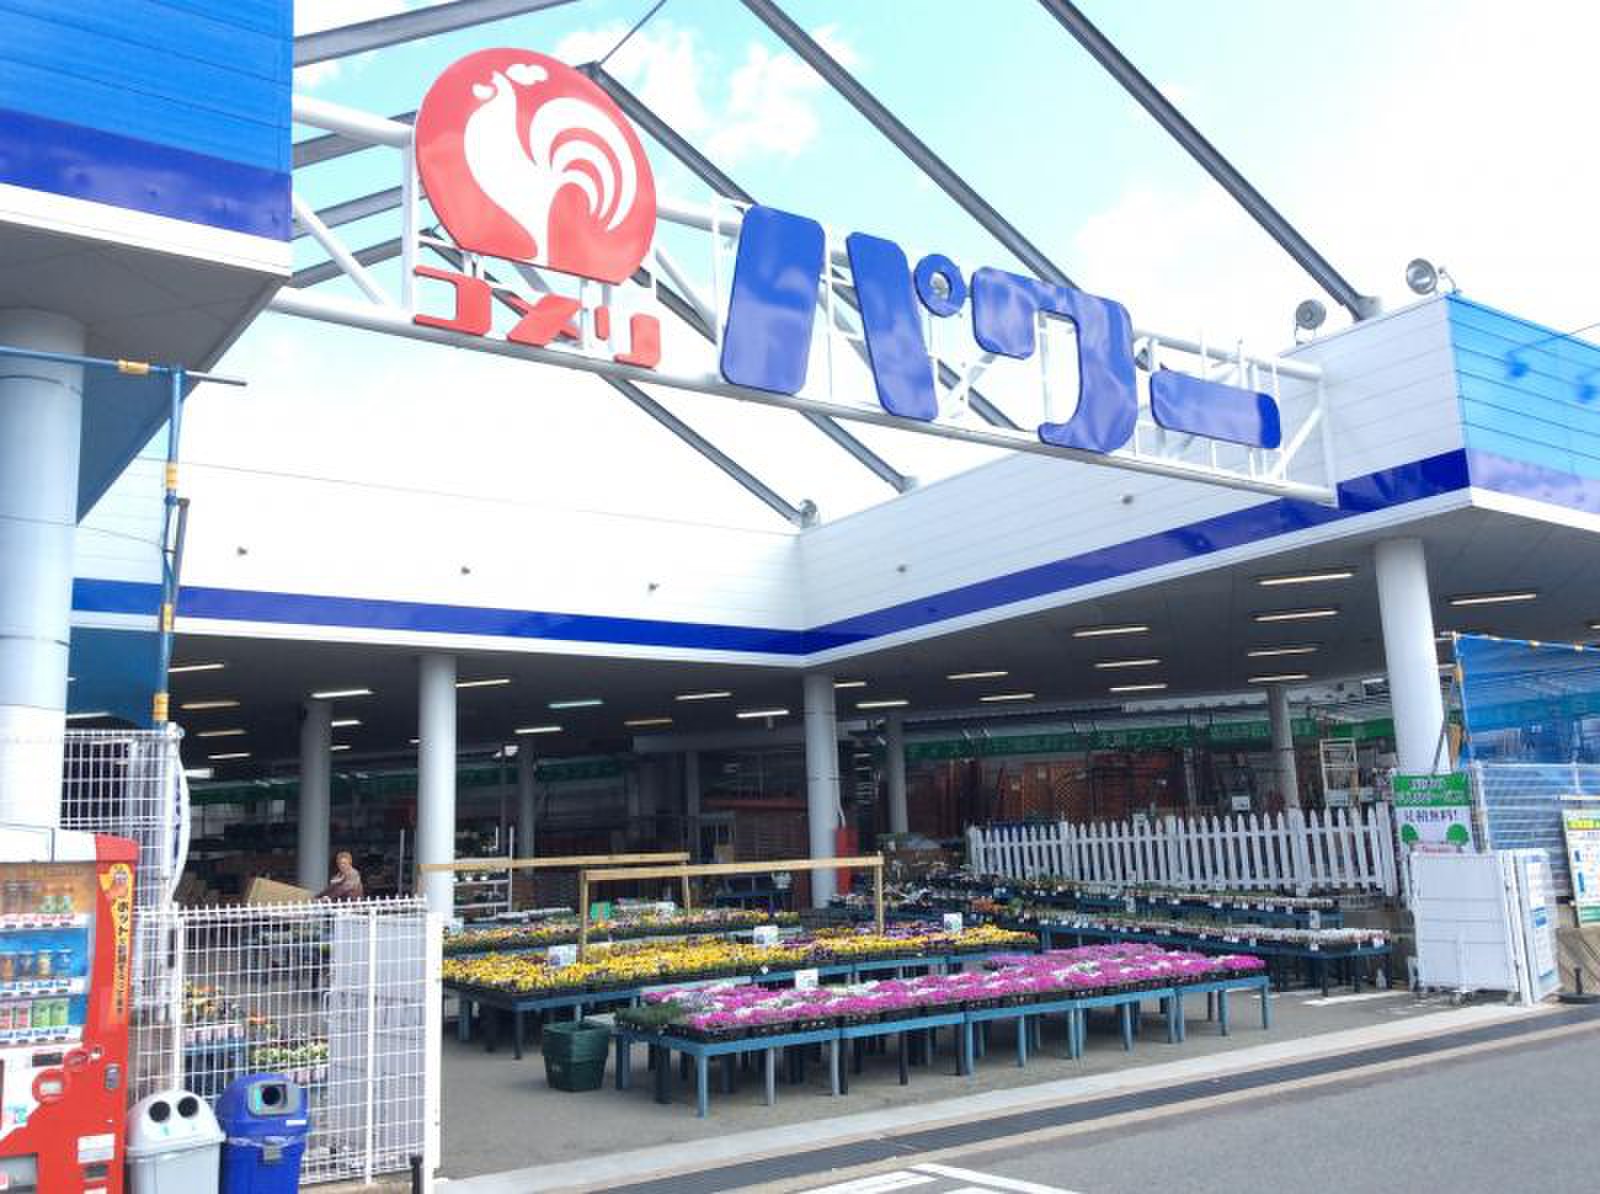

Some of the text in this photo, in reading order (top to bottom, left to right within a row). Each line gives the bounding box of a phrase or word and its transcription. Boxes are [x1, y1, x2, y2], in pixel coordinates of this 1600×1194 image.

[413, 265, 660, 370] コメリ
[720, 204, 1280, 453] パワー
